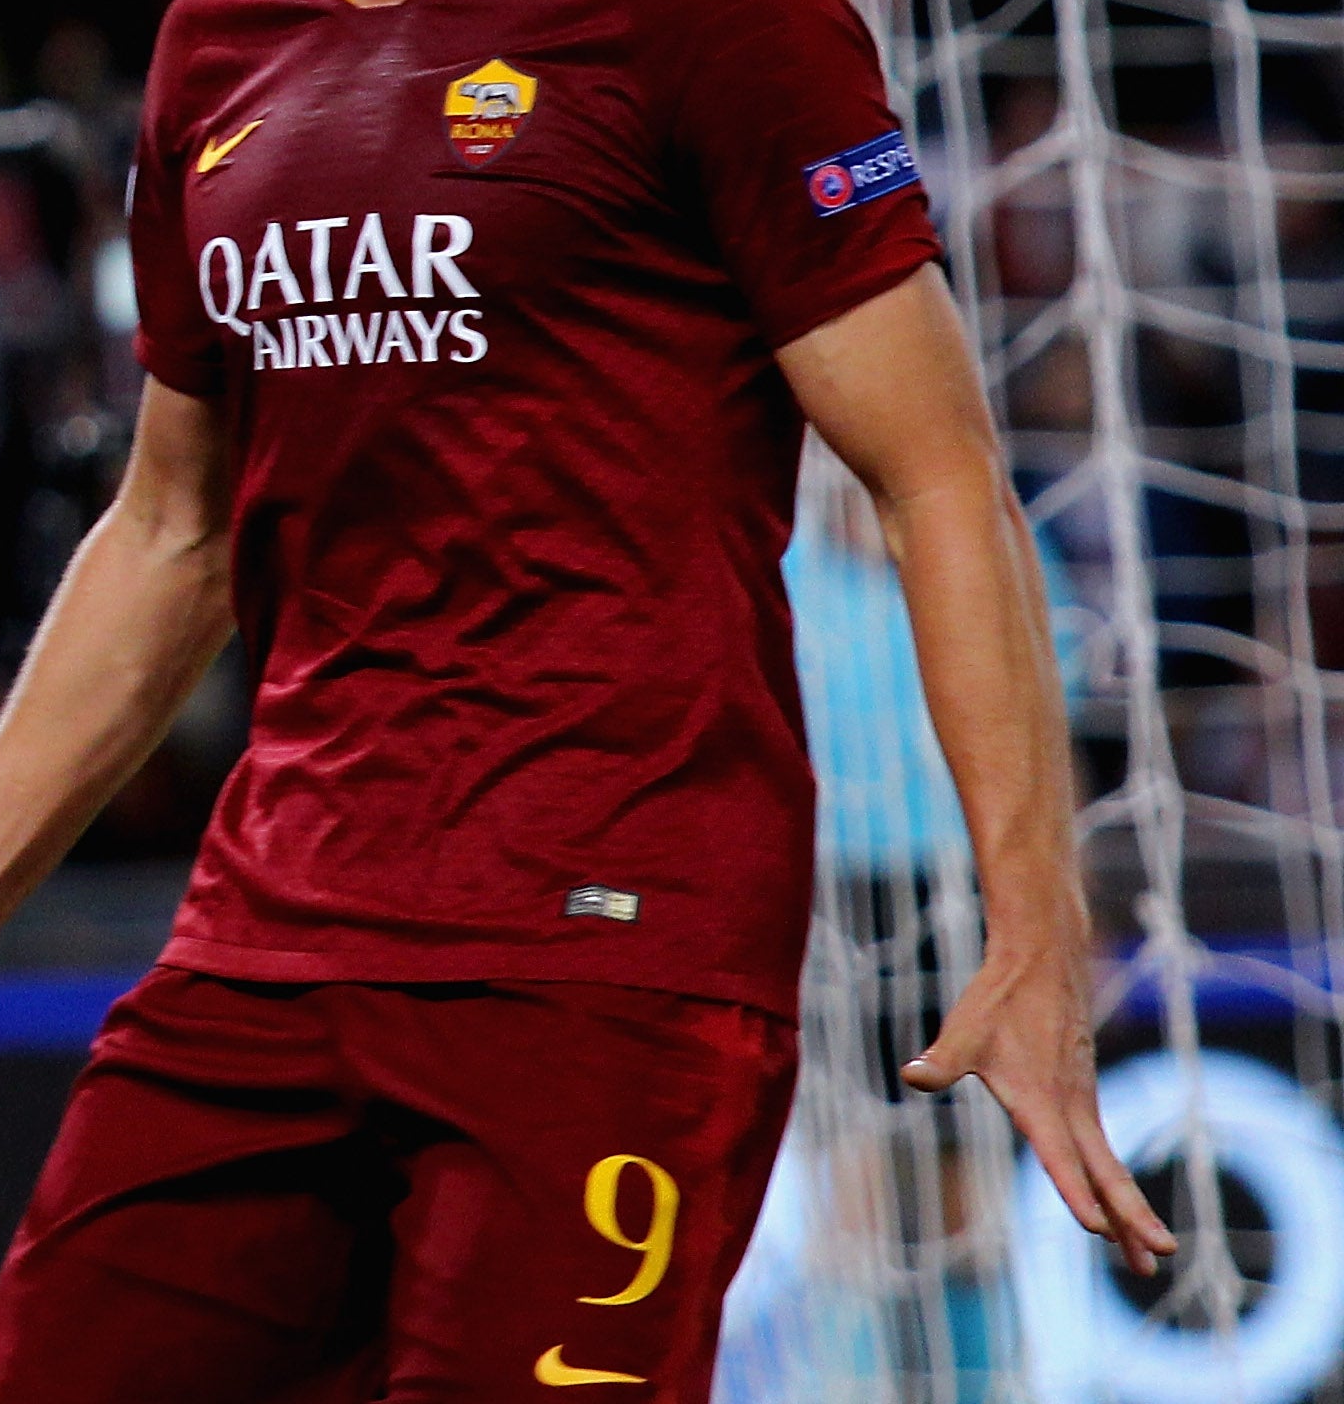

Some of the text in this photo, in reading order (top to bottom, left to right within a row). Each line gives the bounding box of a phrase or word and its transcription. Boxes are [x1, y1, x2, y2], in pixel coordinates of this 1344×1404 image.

[450, 122, 516, 139] ROMA
[199, 212, 481, 337] QATAR
[253, 309, 489, 371] AIRWAYS
[576, 1154, 681, 1306] 9
